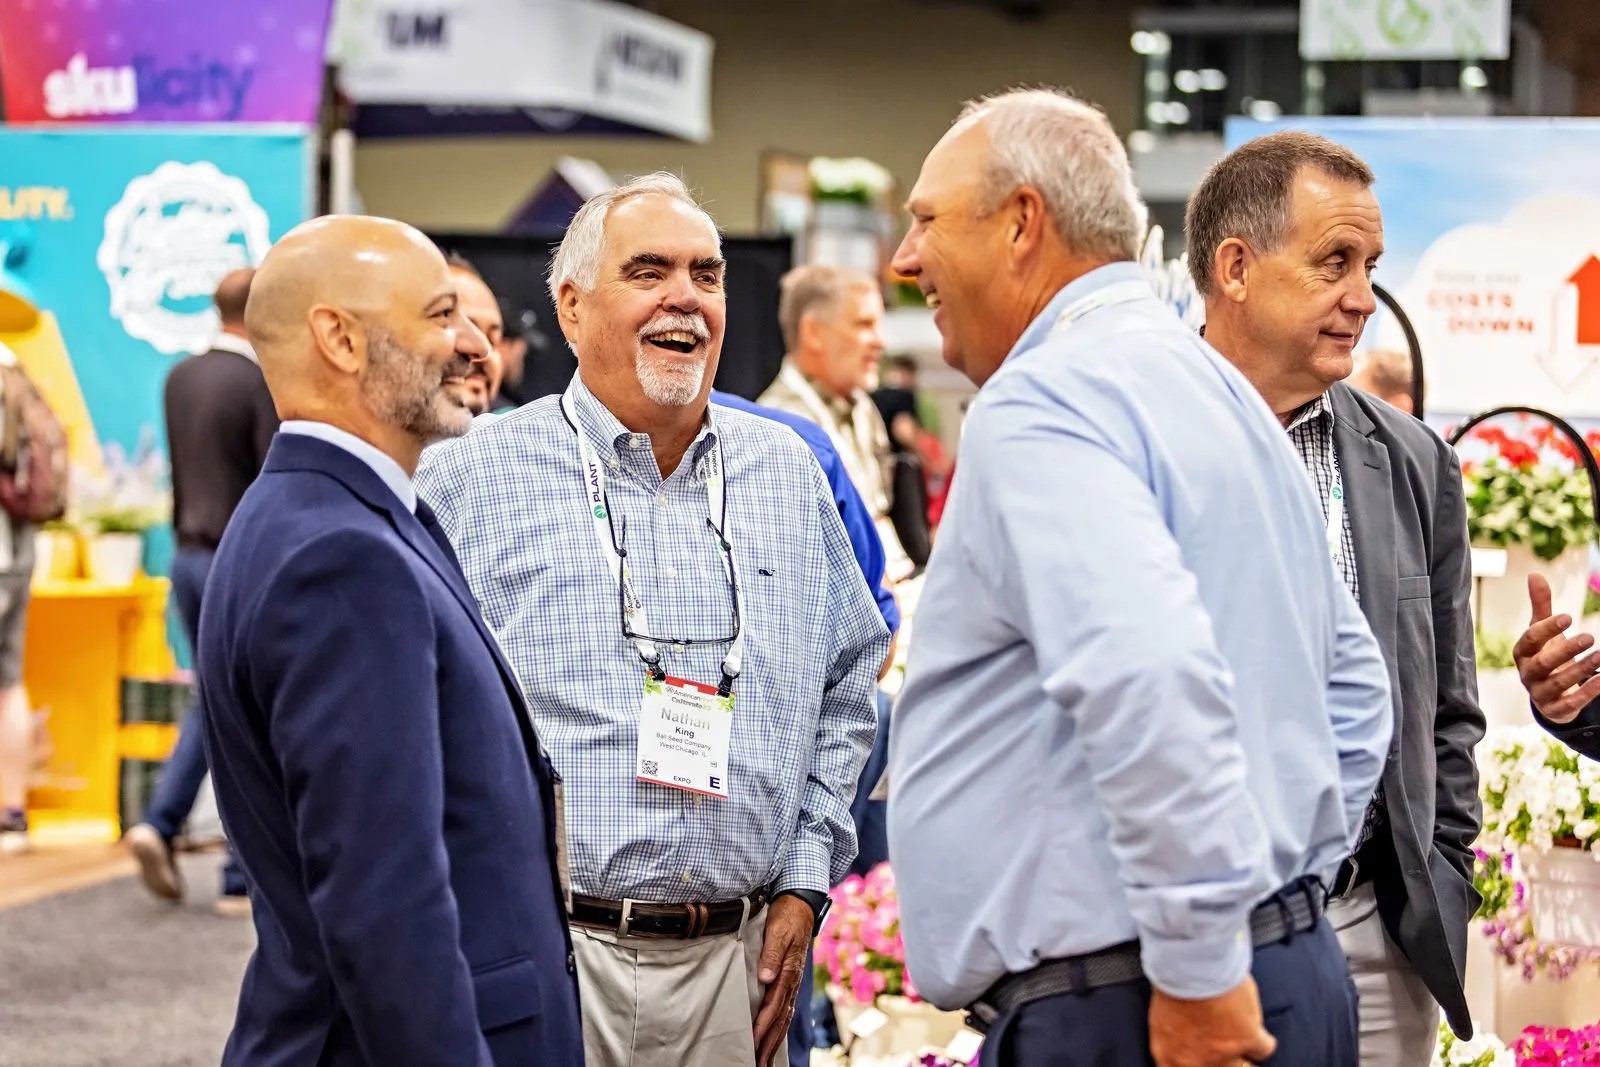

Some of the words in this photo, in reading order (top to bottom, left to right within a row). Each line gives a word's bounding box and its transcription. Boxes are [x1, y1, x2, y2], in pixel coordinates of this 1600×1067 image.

[660, 707, 711, 730] Nathan
[674, 726, 695, 738] King
[659, 741, 675, 750] West
[668, 735, 683, 744] Seed
[684, 738, 711, 750] Company
[673, 775, 692, 785] EXPO
[709, 775, 721, 790] E
